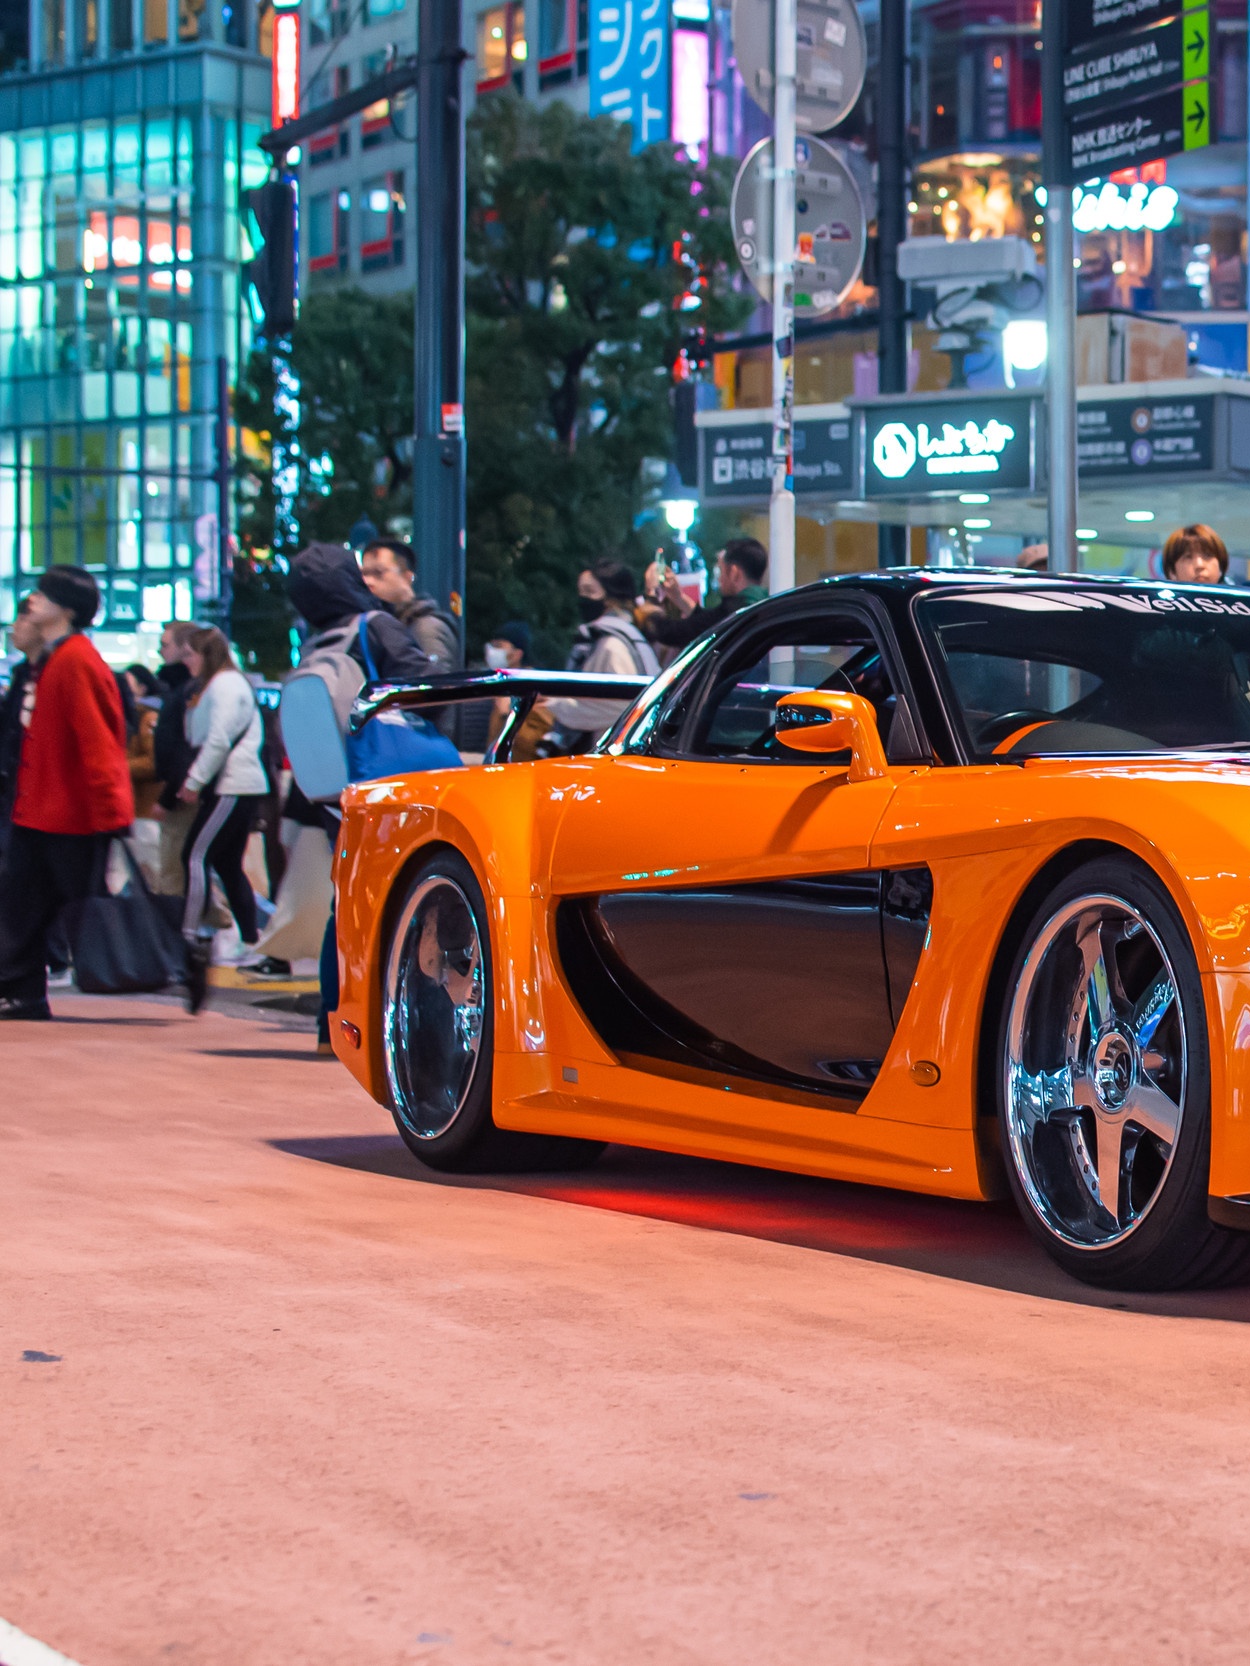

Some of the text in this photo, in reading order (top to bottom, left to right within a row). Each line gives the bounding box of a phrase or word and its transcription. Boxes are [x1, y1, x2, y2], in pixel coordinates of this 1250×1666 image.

[640, 0, 663, 142] クト
[1064, 64, 1085, 86] LINE
[1086, 55, 1112, 79] CUBE
[1113, 41, 1158, 71] SHIBUYA
